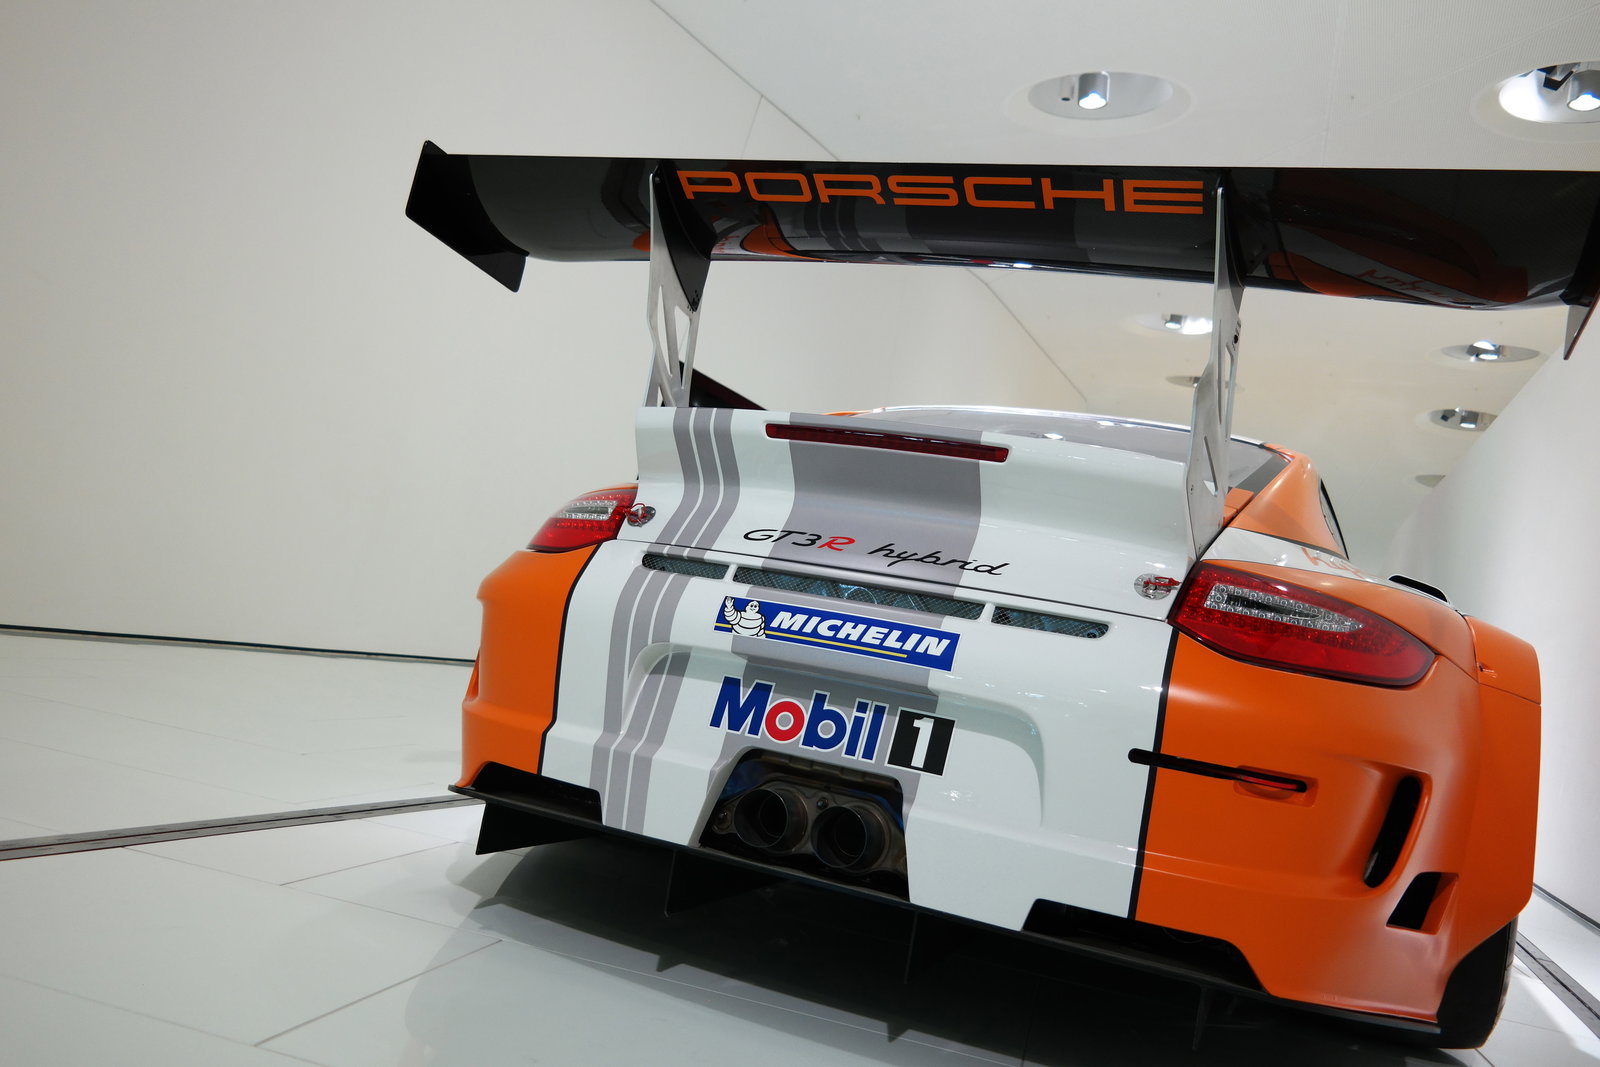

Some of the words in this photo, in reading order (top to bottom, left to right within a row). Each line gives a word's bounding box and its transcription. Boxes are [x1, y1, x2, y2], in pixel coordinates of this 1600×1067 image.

[676, 170, 1204, 214] PORSCHE
[867, 543, 1010, 575] hybrid
[770, 611, 951, 656] MICHELIN
[709, 675, 889, 763] Mobil
[912, 717, 934, 768] 1
